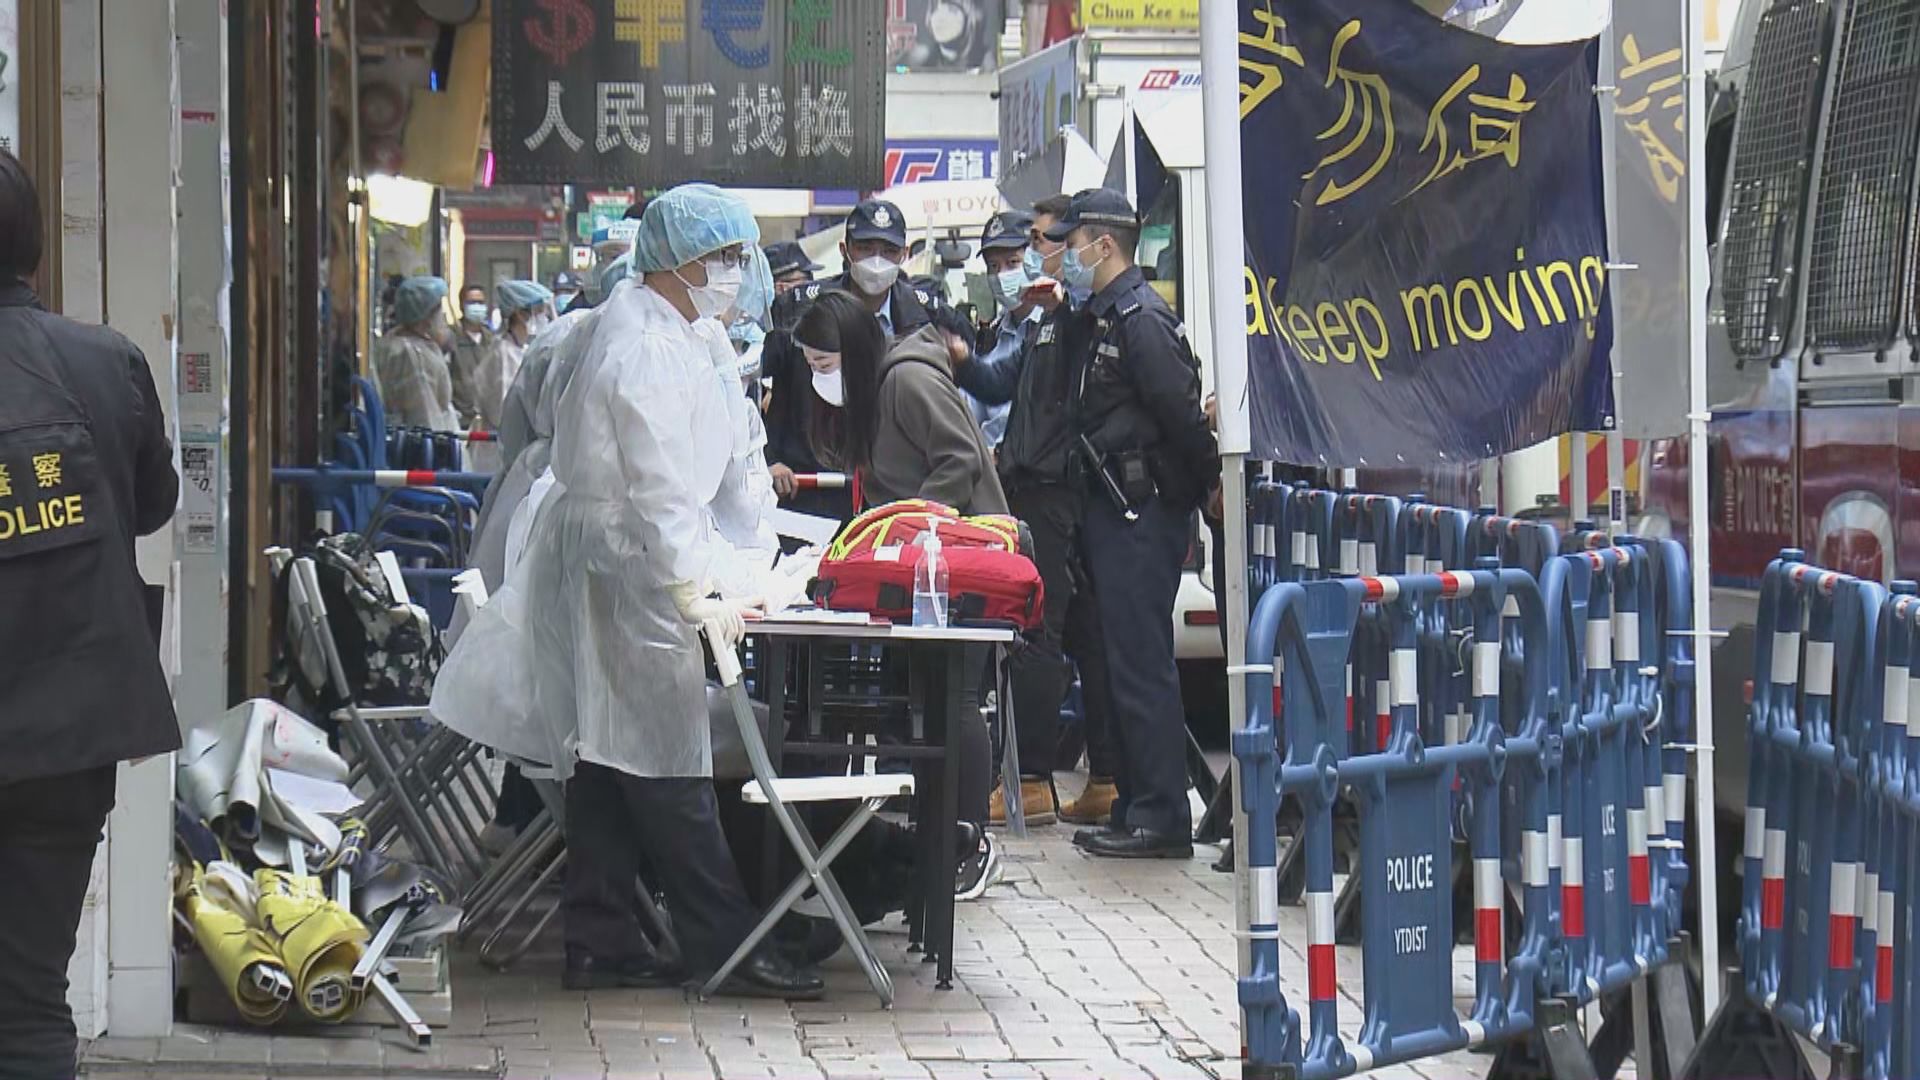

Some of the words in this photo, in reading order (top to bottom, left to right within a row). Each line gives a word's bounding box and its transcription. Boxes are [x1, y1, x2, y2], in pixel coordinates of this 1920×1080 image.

[1090, 2, 1135, 19] Chun
[1143, 3, 1173, 19] Kee
[1400, 247, 1606, 351] moving
[1387, 854, 1434, 893] POLICE
